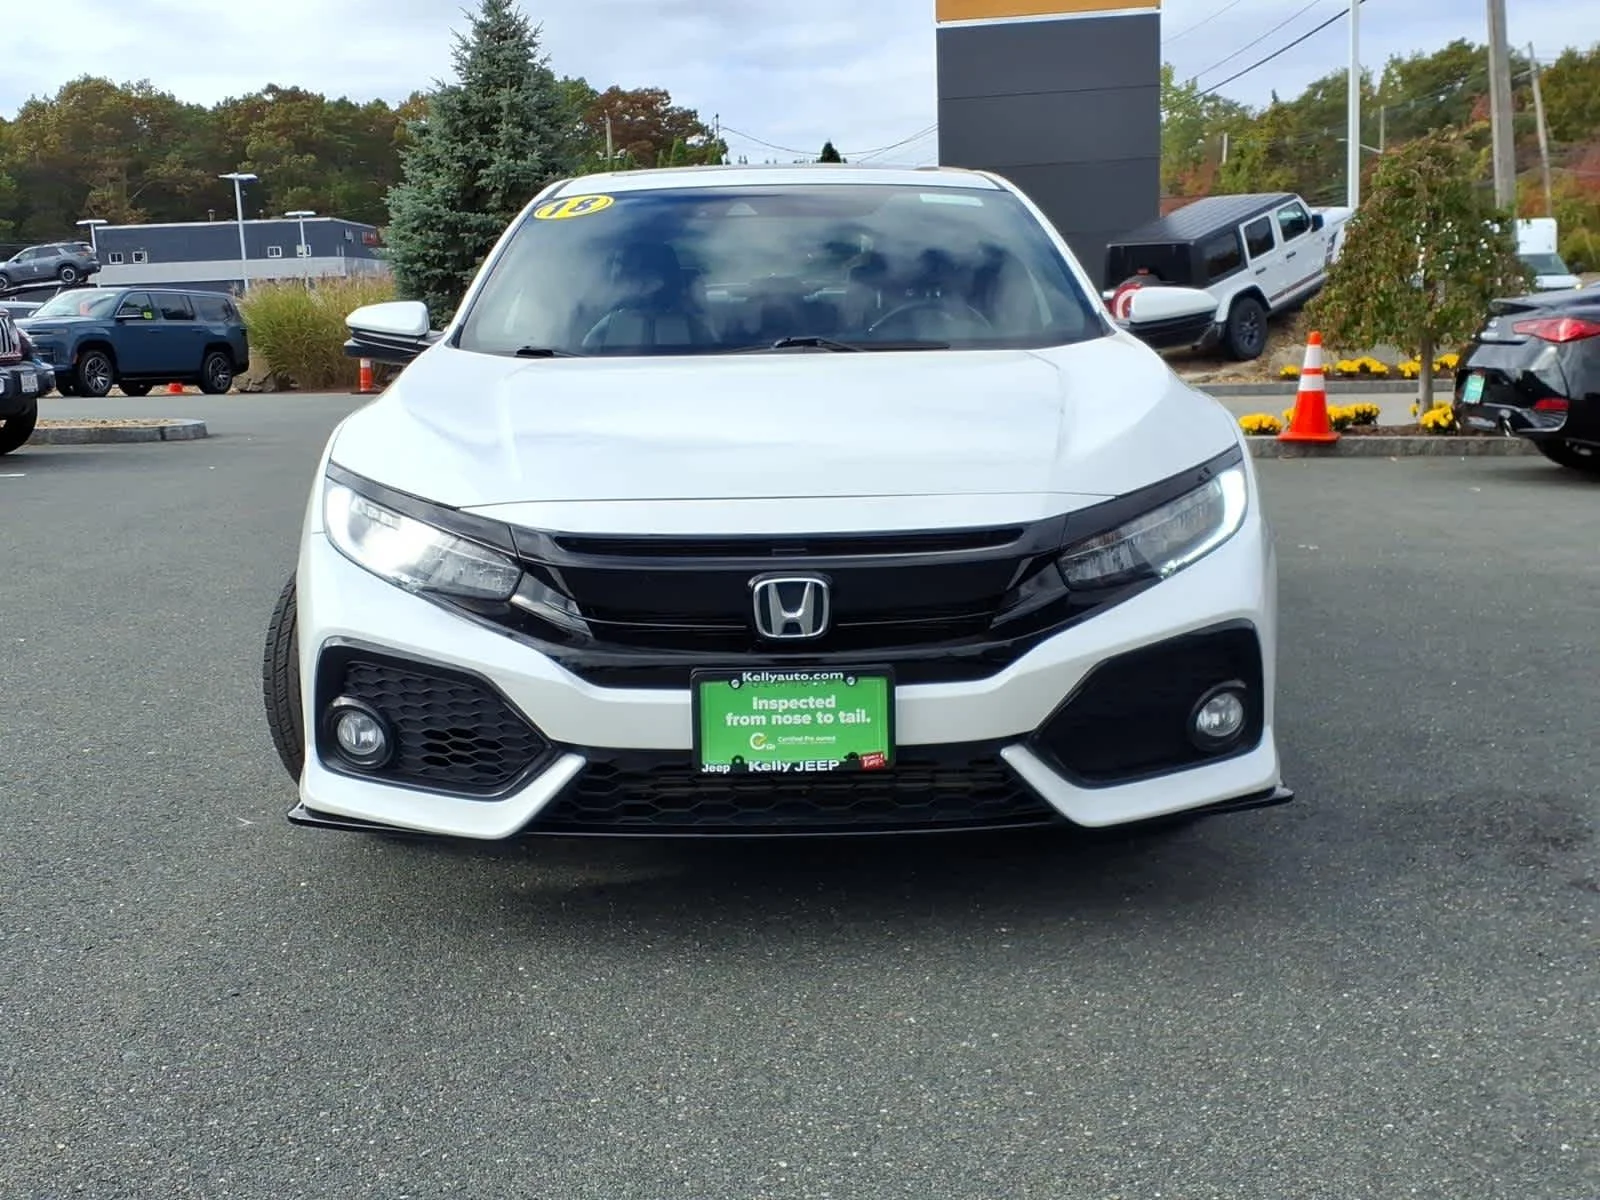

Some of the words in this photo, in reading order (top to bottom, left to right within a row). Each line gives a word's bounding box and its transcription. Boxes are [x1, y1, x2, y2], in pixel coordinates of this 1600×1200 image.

[742, 672, 844, 683] Kellyauto.com
[752, 695, 837, 712] Inspected
[725, 713, 767, 726] from
[771, 714, 812, 726] nose
[816, 711, 835, 725] to
[839, 709, 872, 725] tail.
[701, 763, 731, 775] Jeep
[748, 760, 792, 773] Kelly
[794, 760, 840, 772] JEEP
